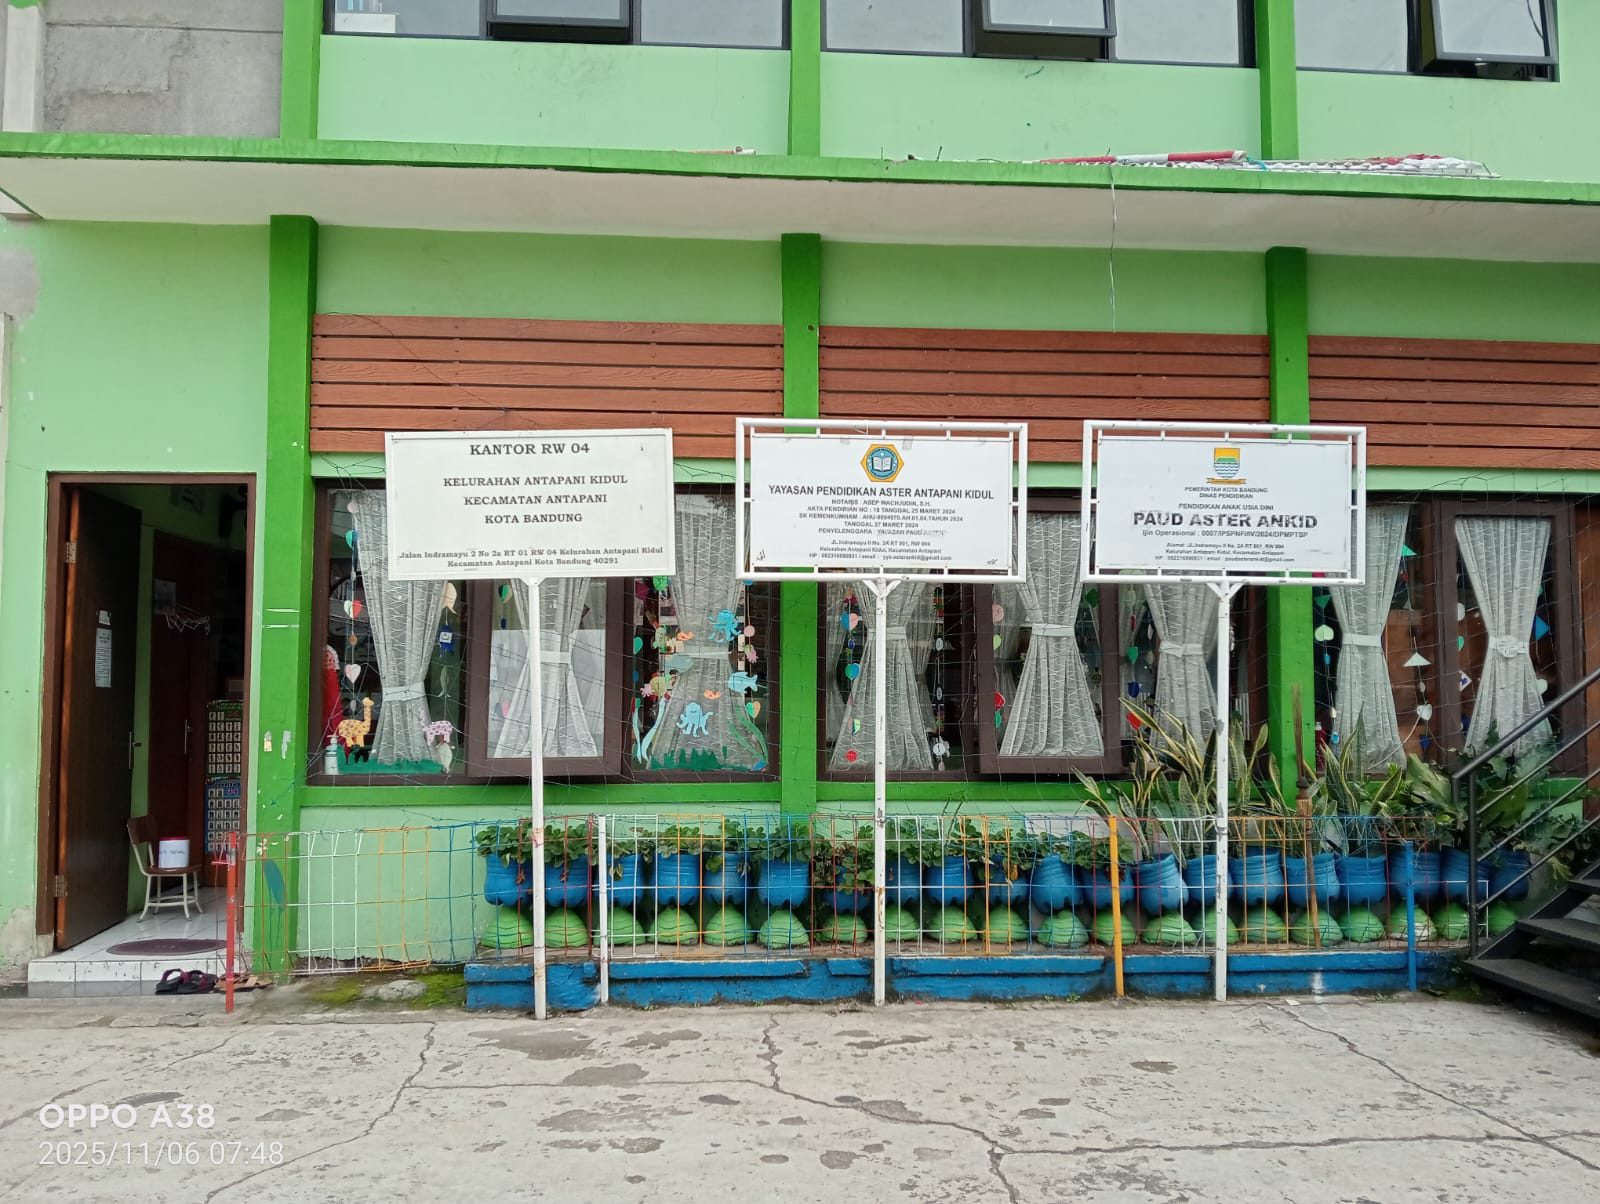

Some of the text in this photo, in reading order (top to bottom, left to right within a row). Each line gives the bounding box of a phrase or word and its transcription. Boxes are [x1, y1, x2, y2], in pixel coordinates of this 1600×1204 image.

[470, 442, 590, 456] KANTOR RW 04
[443, 475, 628, 487] KELURAHAN ANTAPANI KIDUL
[768, 485, 994, 500] YAYASAN PENDIDIKAN ASTER ANTAPANI KIDUL
[464, 494, 608, 506] KECAMATAN ANTAPANI
[484, 514, 583, 524] KOTA BANDUNG
[1133, 512, 1318, 529] PAUD ASTER ANKID
[1142, 529, 1154, 537] Ijin
[398, 551, 422, 559] Jalan
[424, 550, 468, 560] Indramayu
[603, 548, 640, 556] Antapani
[642, 546, 664, 554] Kidul
[495, 560, 533, 568] Antapani
[556, 558, 592, 567] Bandung
